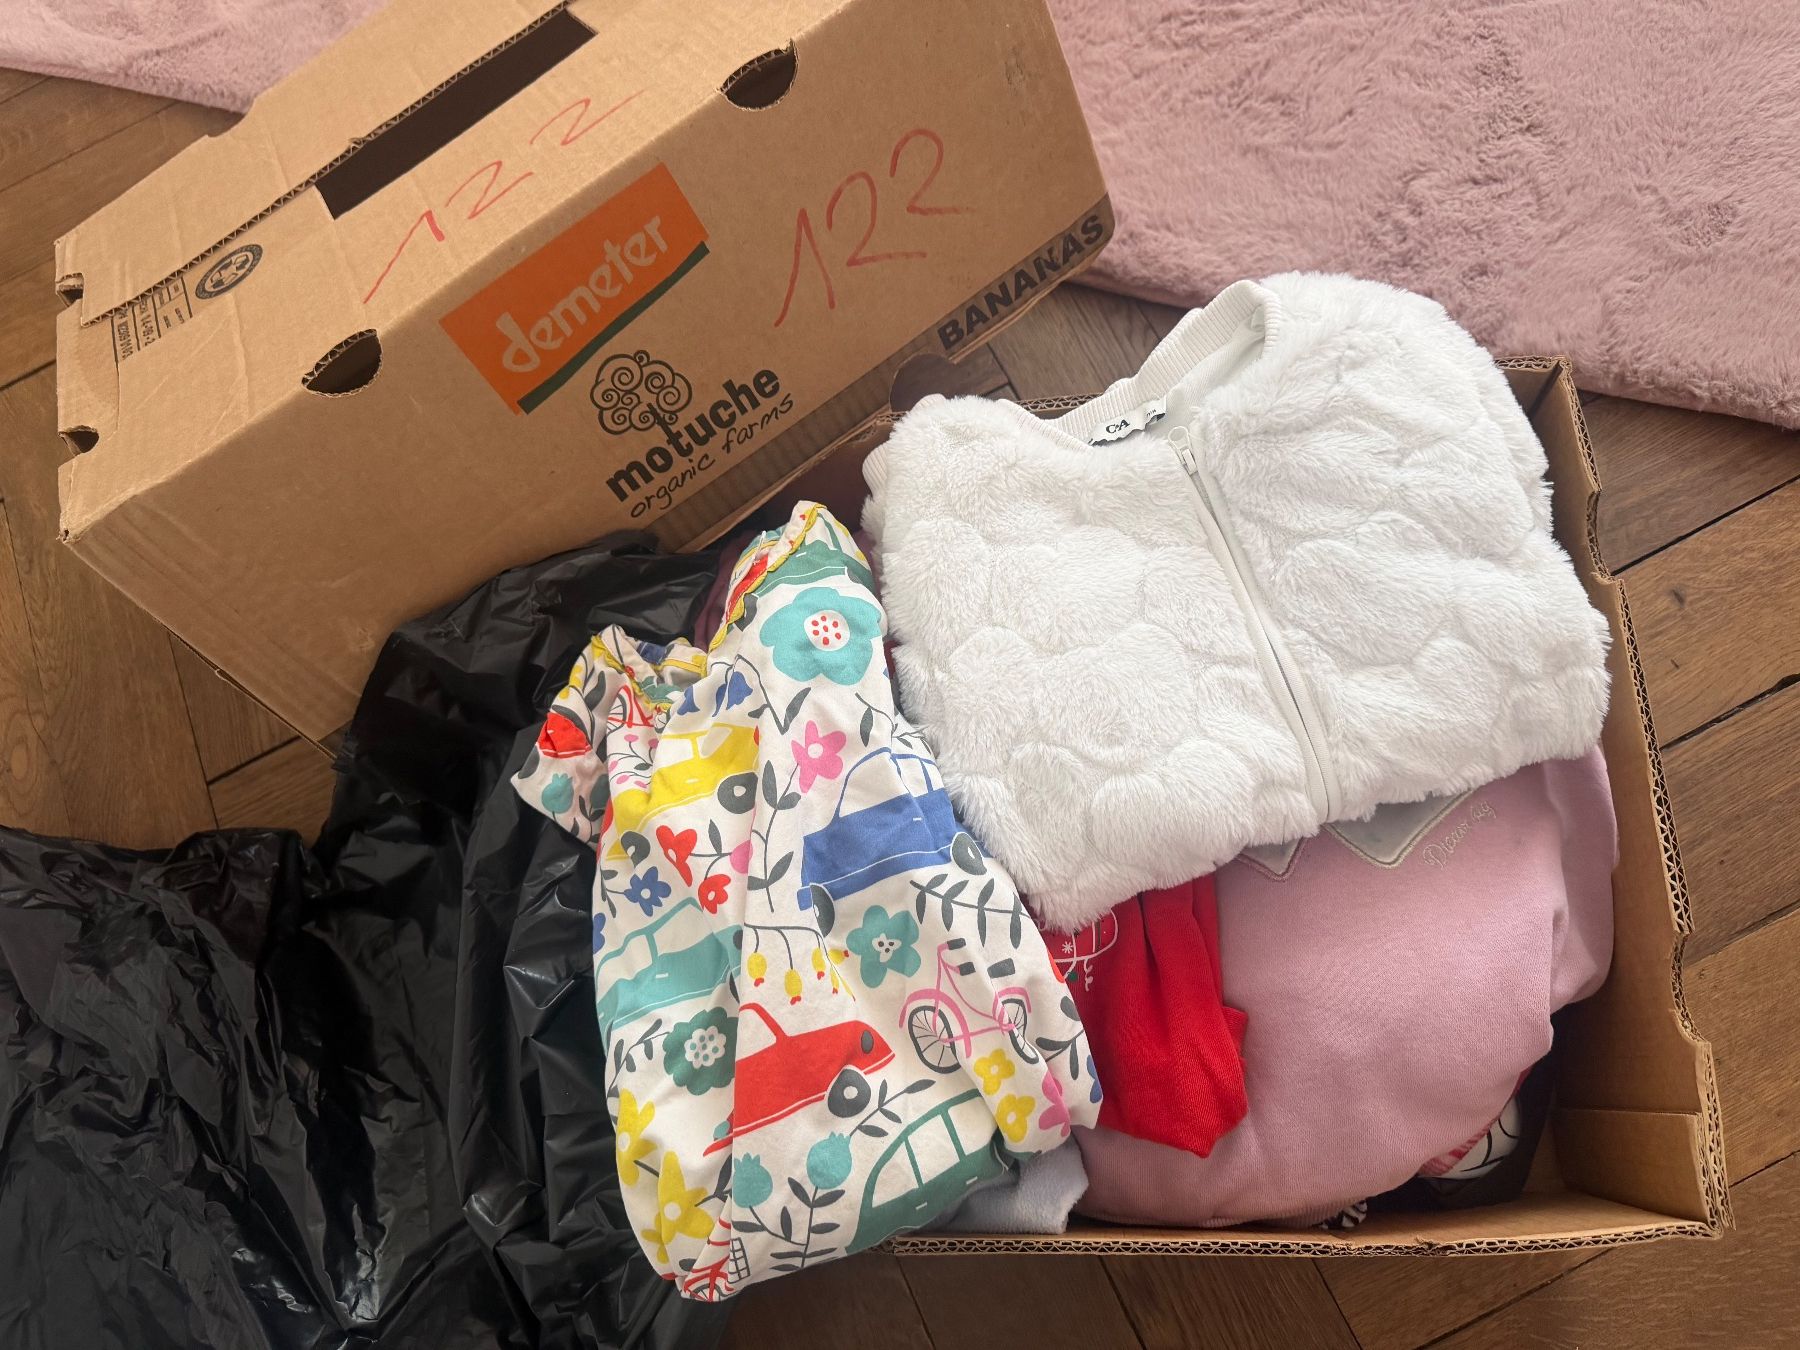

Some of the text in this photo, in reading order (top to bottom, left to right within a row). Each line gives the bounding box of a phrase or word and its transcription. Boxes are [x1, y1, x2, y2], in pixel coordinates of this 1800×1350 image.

[363, 88, 646, 304] 122
[773, 128, 977, 328] 122
[495, 215, 668, 373] demeter
[937, 215, 1104, 350] BANANAS
[606, 369, 780, 502] motuche
[630, 392, 794, 518] organic farms
